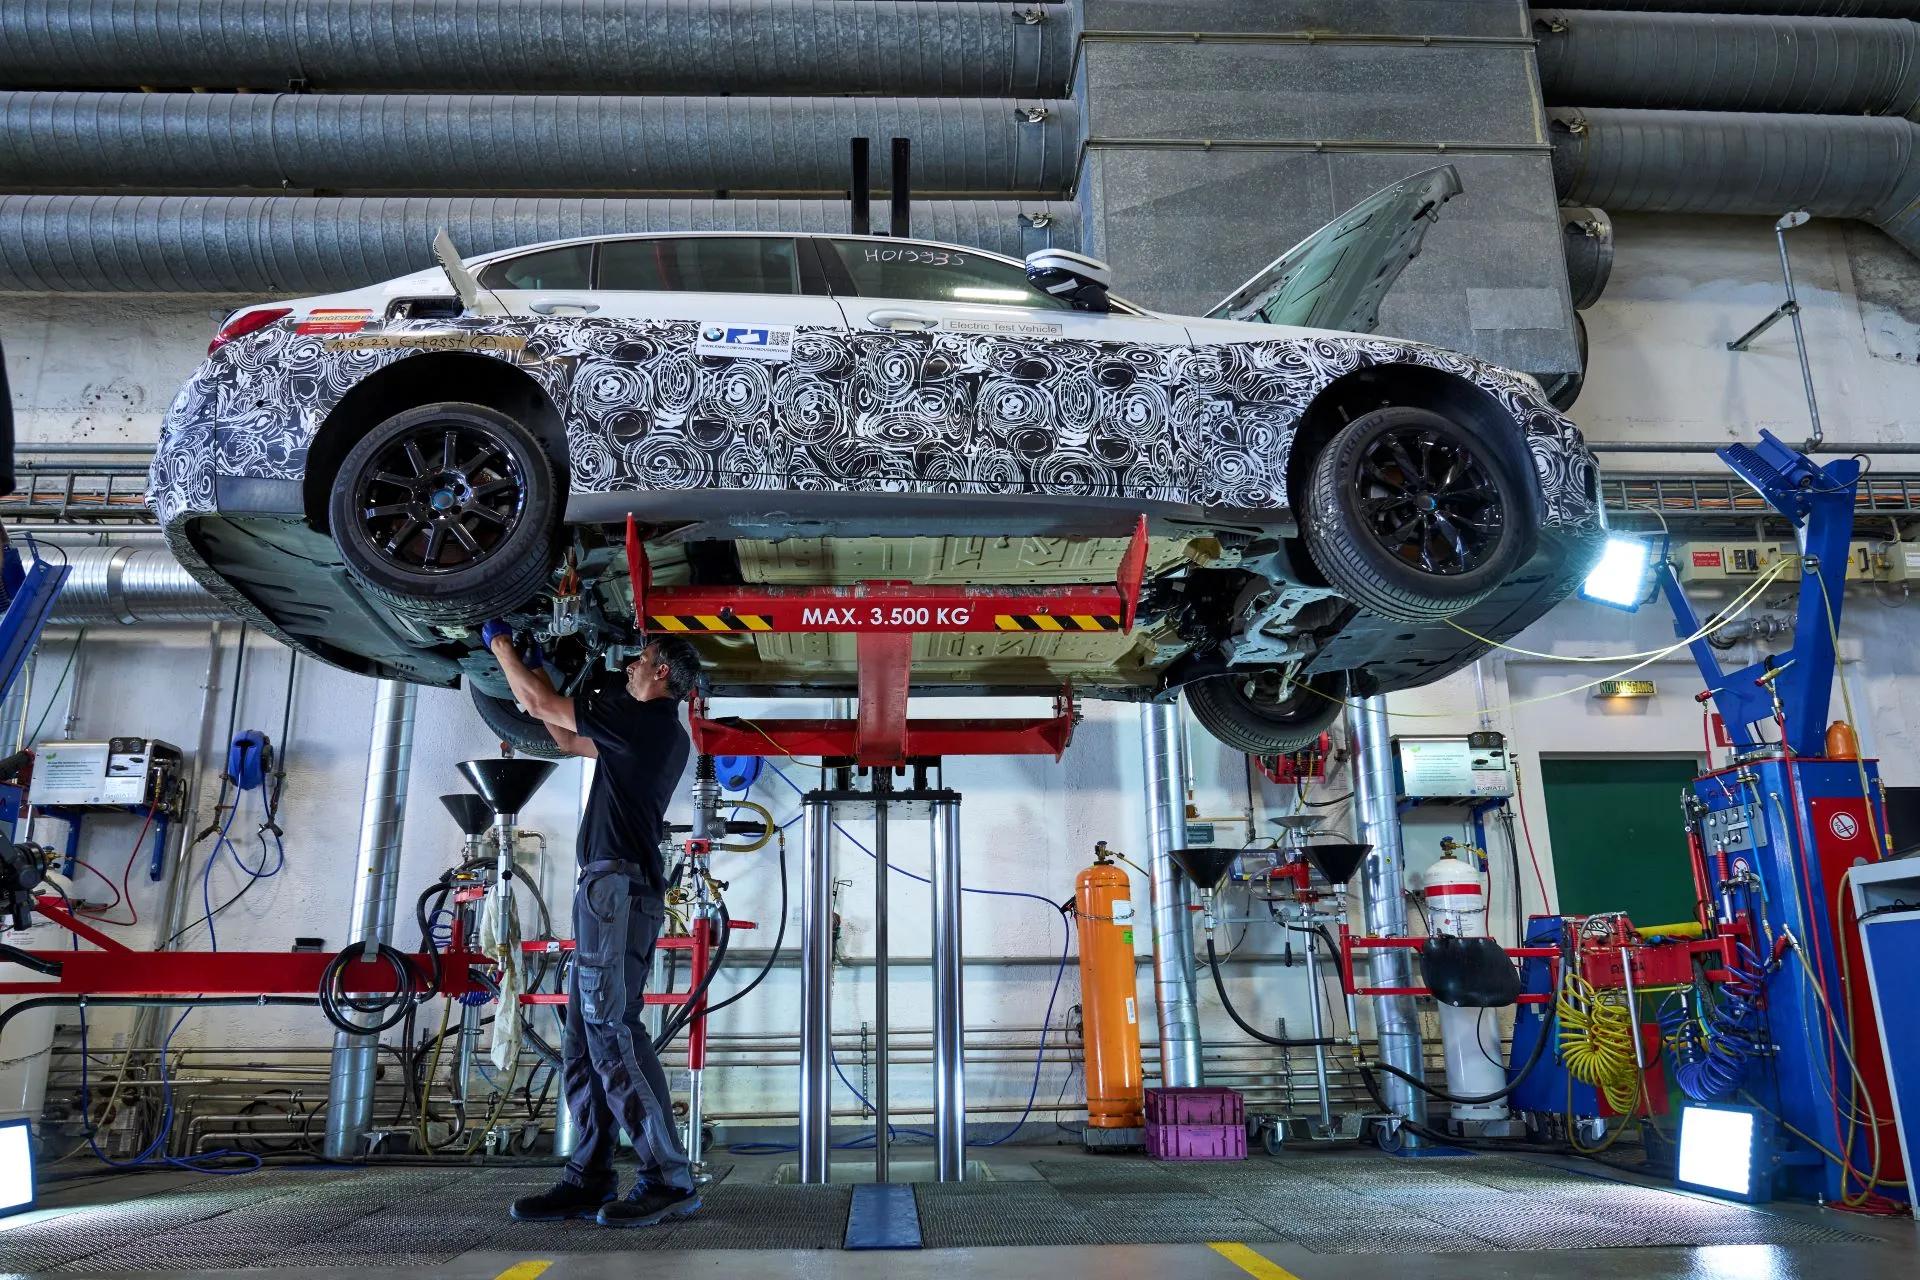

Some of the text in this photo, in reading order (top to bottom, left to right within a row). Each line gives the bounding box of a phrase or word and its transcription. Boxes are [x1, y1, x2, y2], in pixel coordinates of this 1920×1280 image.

[950, 320, 1057, 334] Electric Test Vehicle
[802, 607, 970, 625] MAX. 3.500 KG
[1600, 681, 1653, 694] NOTAUSGANG
